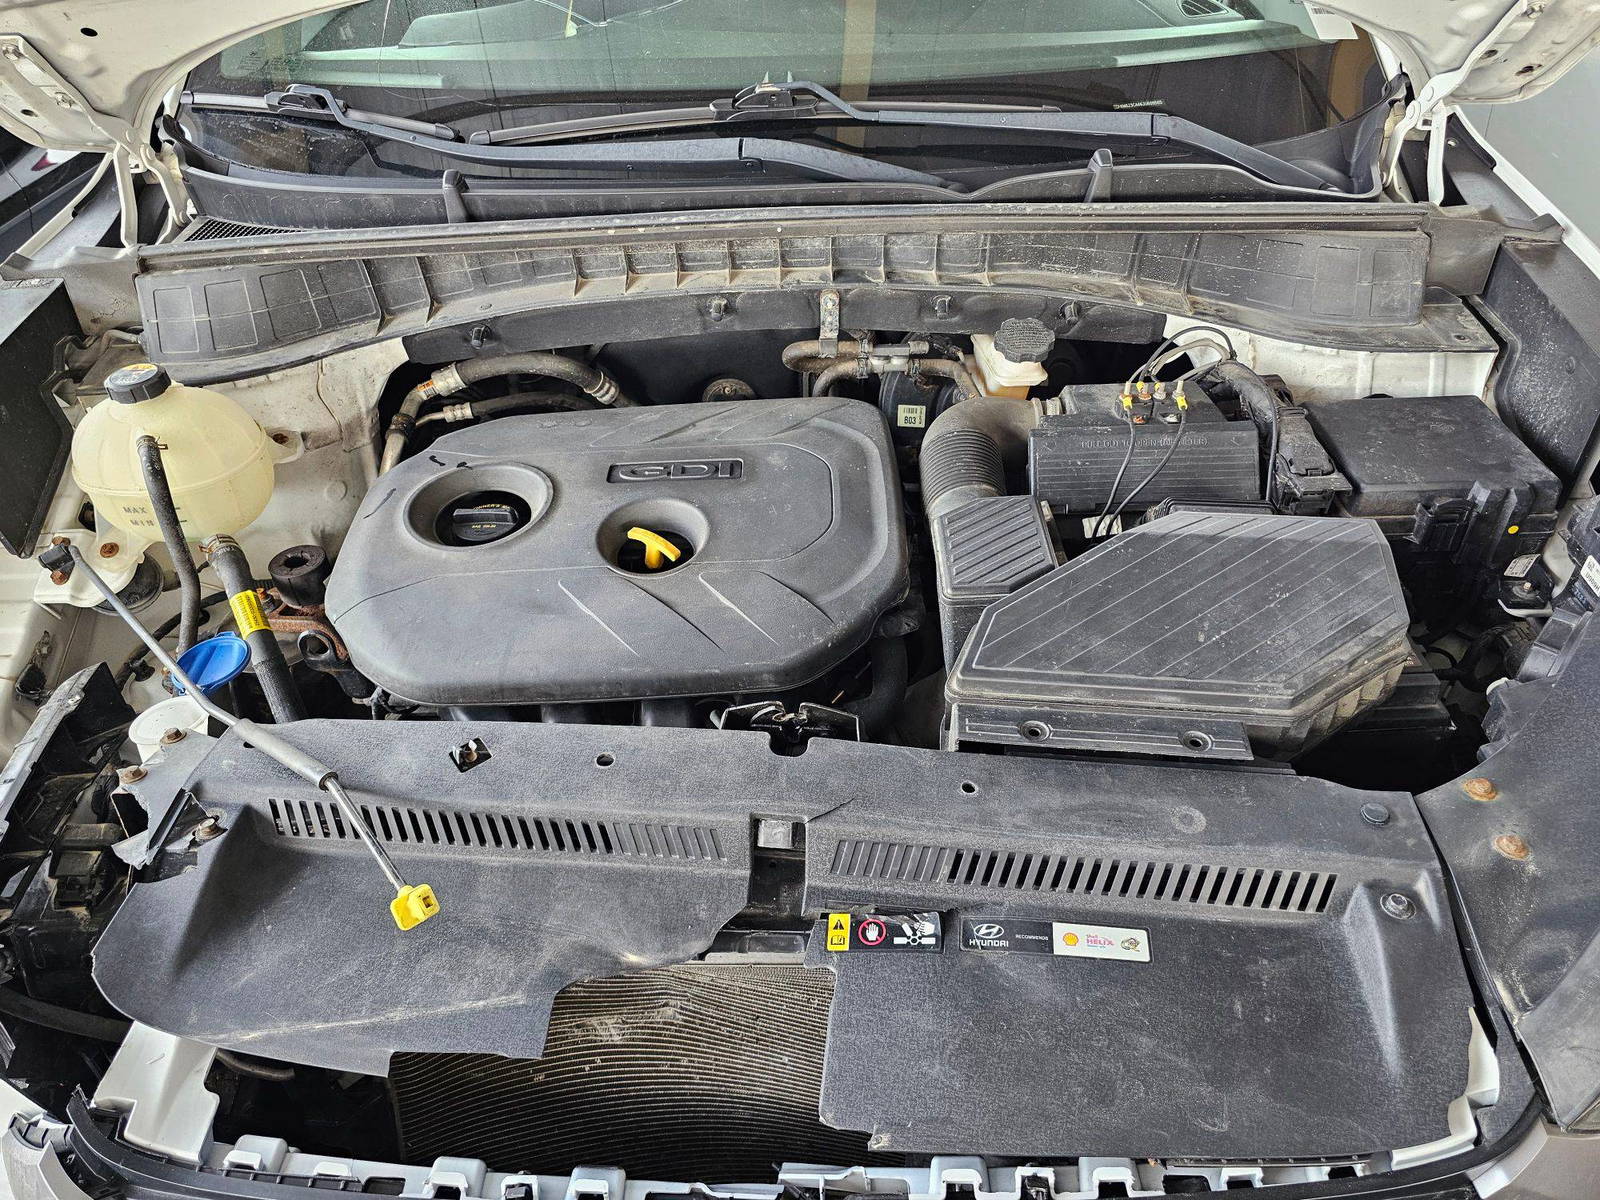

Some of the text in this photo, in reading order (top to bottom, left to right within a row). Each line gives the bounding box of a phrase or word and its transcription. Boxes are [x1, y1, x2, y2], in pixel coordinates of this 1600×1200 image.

[618, 461, 734, 481] GDI
[122, 506, 147, 514] MAX
[129, 519, 155, 527] MIN
[969, 939, 1009, 947] HYUNDAI
[1086, 937, 1115, 946] HELIX
